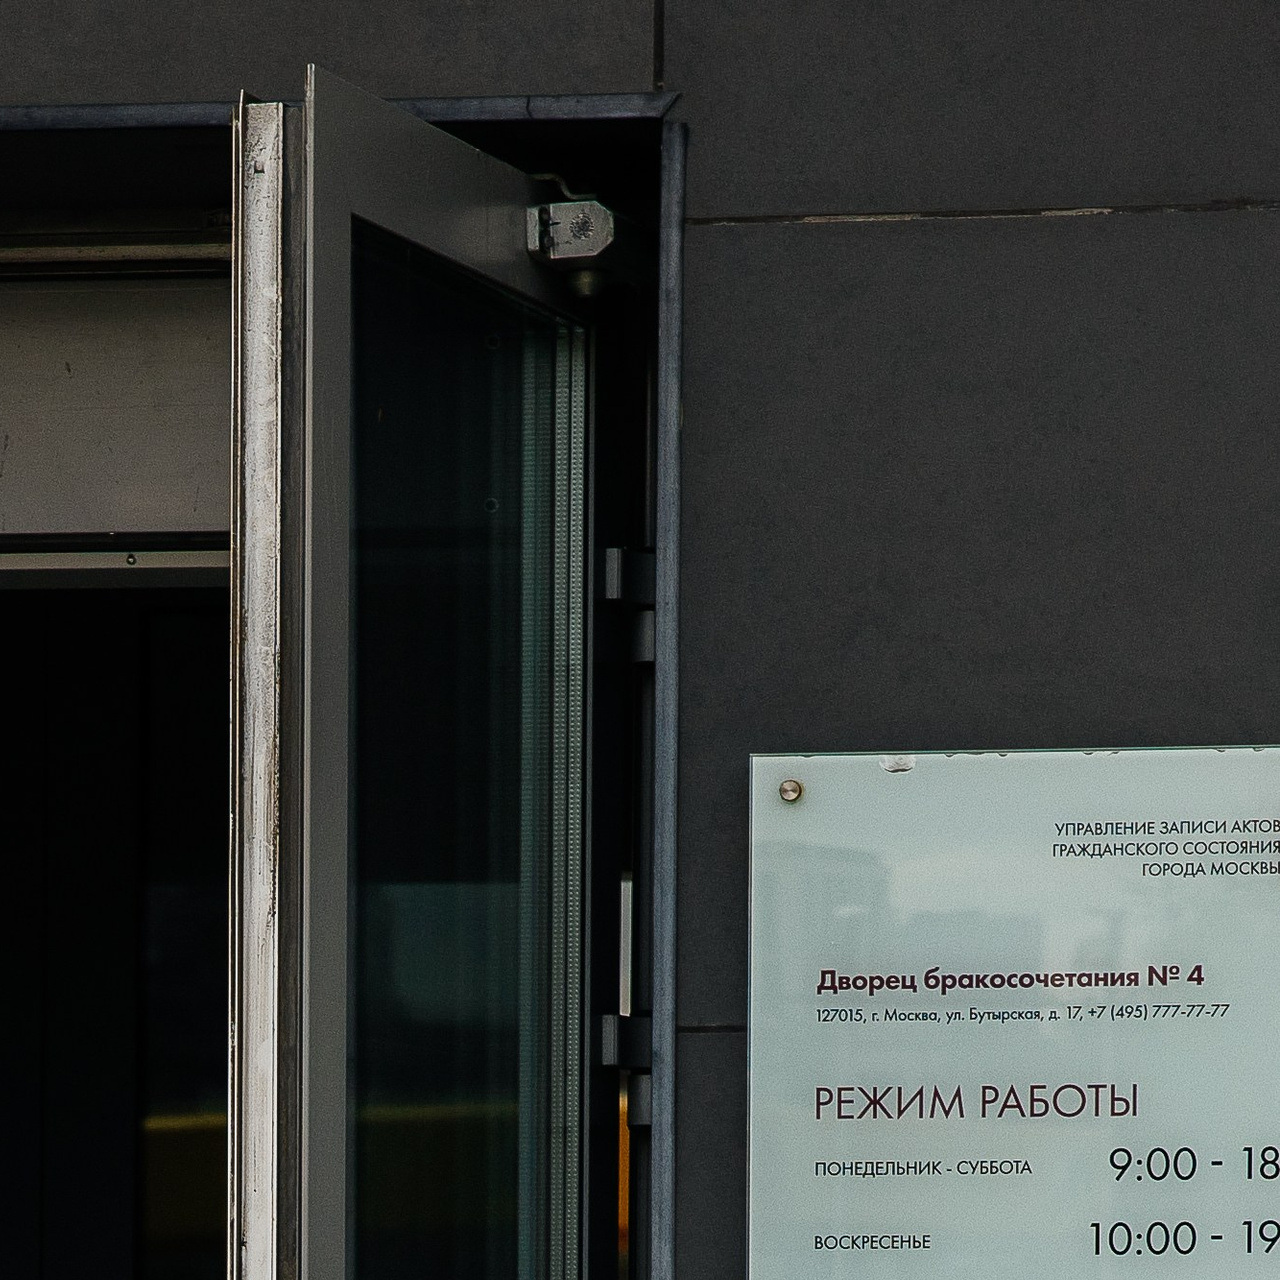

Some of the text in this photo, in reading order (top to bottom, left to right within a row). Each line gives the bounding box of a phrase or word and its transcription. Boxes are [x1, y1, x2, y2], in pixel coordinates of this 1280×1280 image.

[1055, 820, 1280, 836] УПРАВЛЕНИЕ ЗАПИСИ АКТОВ
[1053, 840, 1280, 859] ГРАЖДАНСКОГО СОСТОЯНИЯ
[1142, 861, 1280, 878] ГОРОДА МОСКВЫ
[817, 964, 1205, 995] Дворец бракосочетания № 4
[816, 1003, 1231, 1024] 127015, г. Москва, ул. Бутырская, д. 17, +7 (495) 777-77-77
[815, 1083, 1139, 1120] РЕЖИМ РАБОТЫ
[815, 1161, 942, 1178] ПОНЕДЕЛЬНИК
[957, 1159, 1033, 1175] СУББОТА
[1109, 1147, 1197, 1181] 9:00
[814, 1234, 932, 1251] ВОСКРЕСЕНЬЕ
[1090, 1220, 1197, 1255] 10:00
